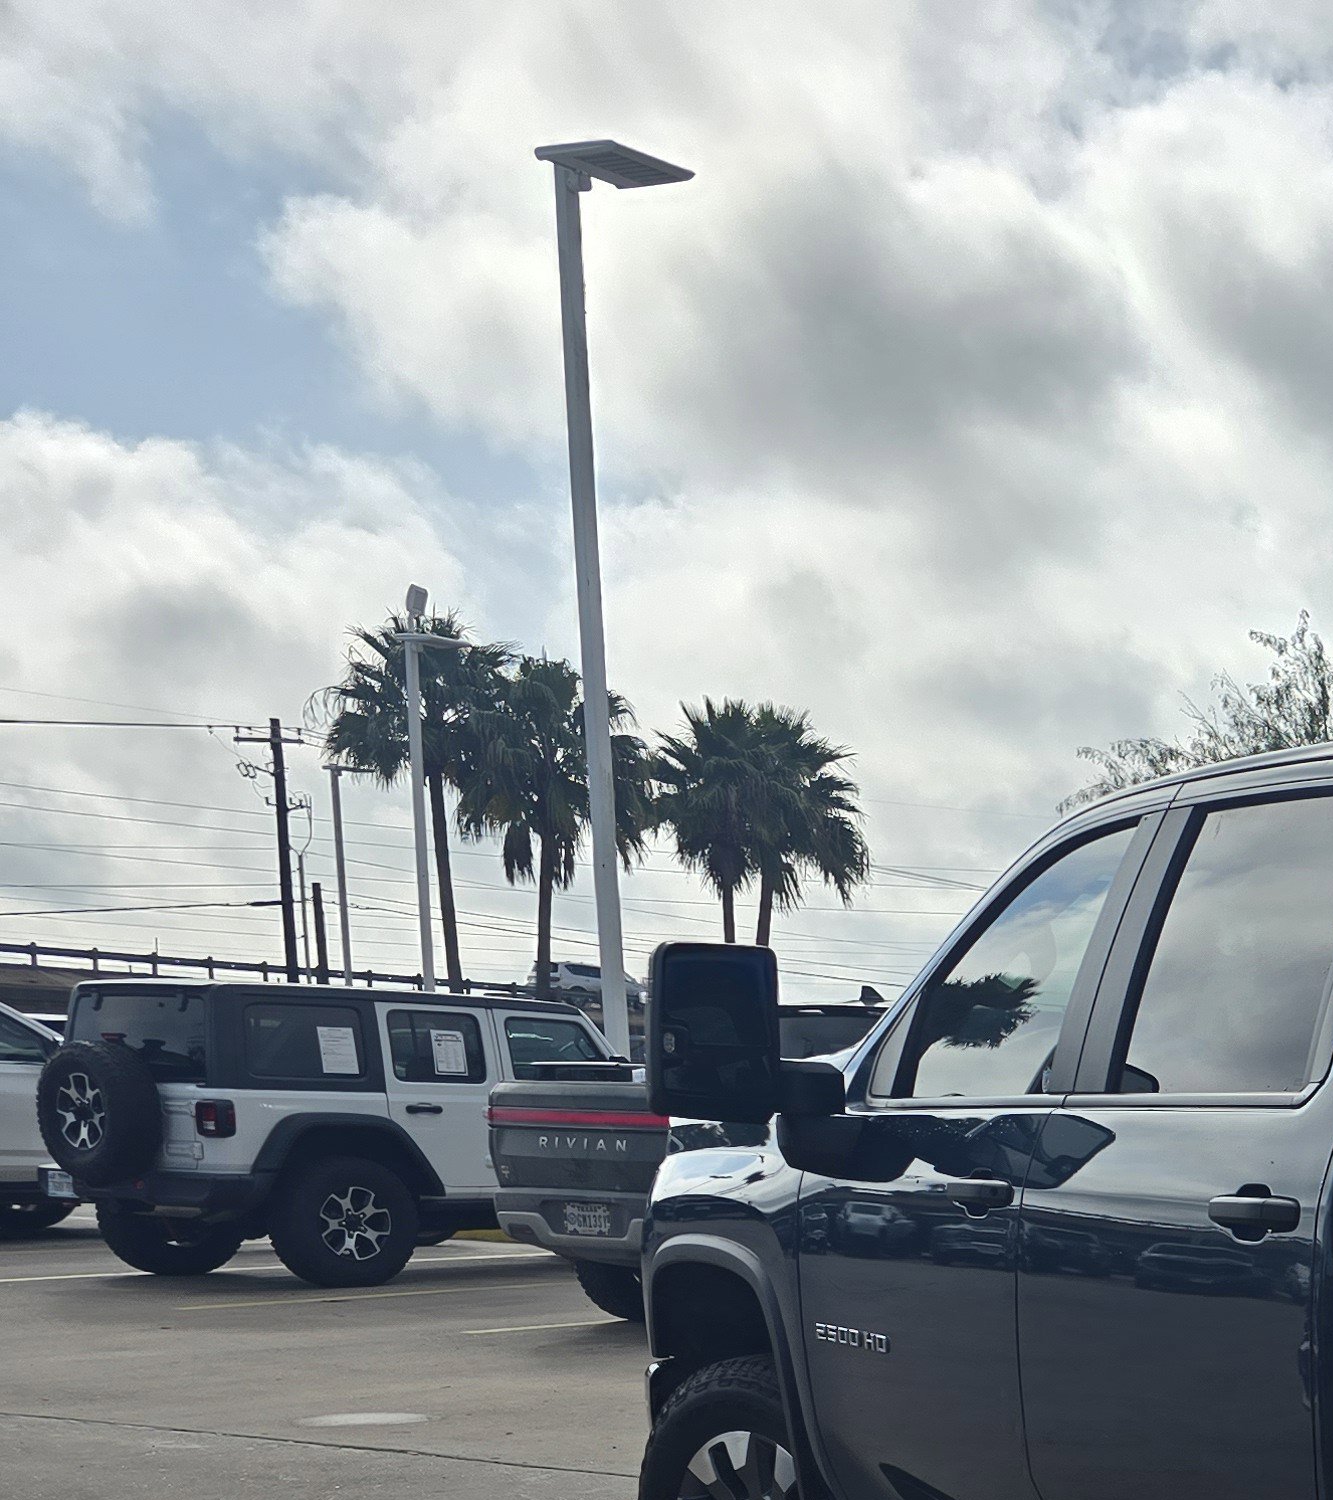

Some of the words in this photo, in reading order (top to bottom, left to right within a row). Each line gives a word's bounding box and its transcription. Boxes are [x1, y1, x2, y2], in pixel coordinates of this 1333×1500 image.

[539, 1136, 627, 1151] RIVIAN
[815, 1322, 861, 1347] 2500
[862, 1330, 889, 1354] HD
